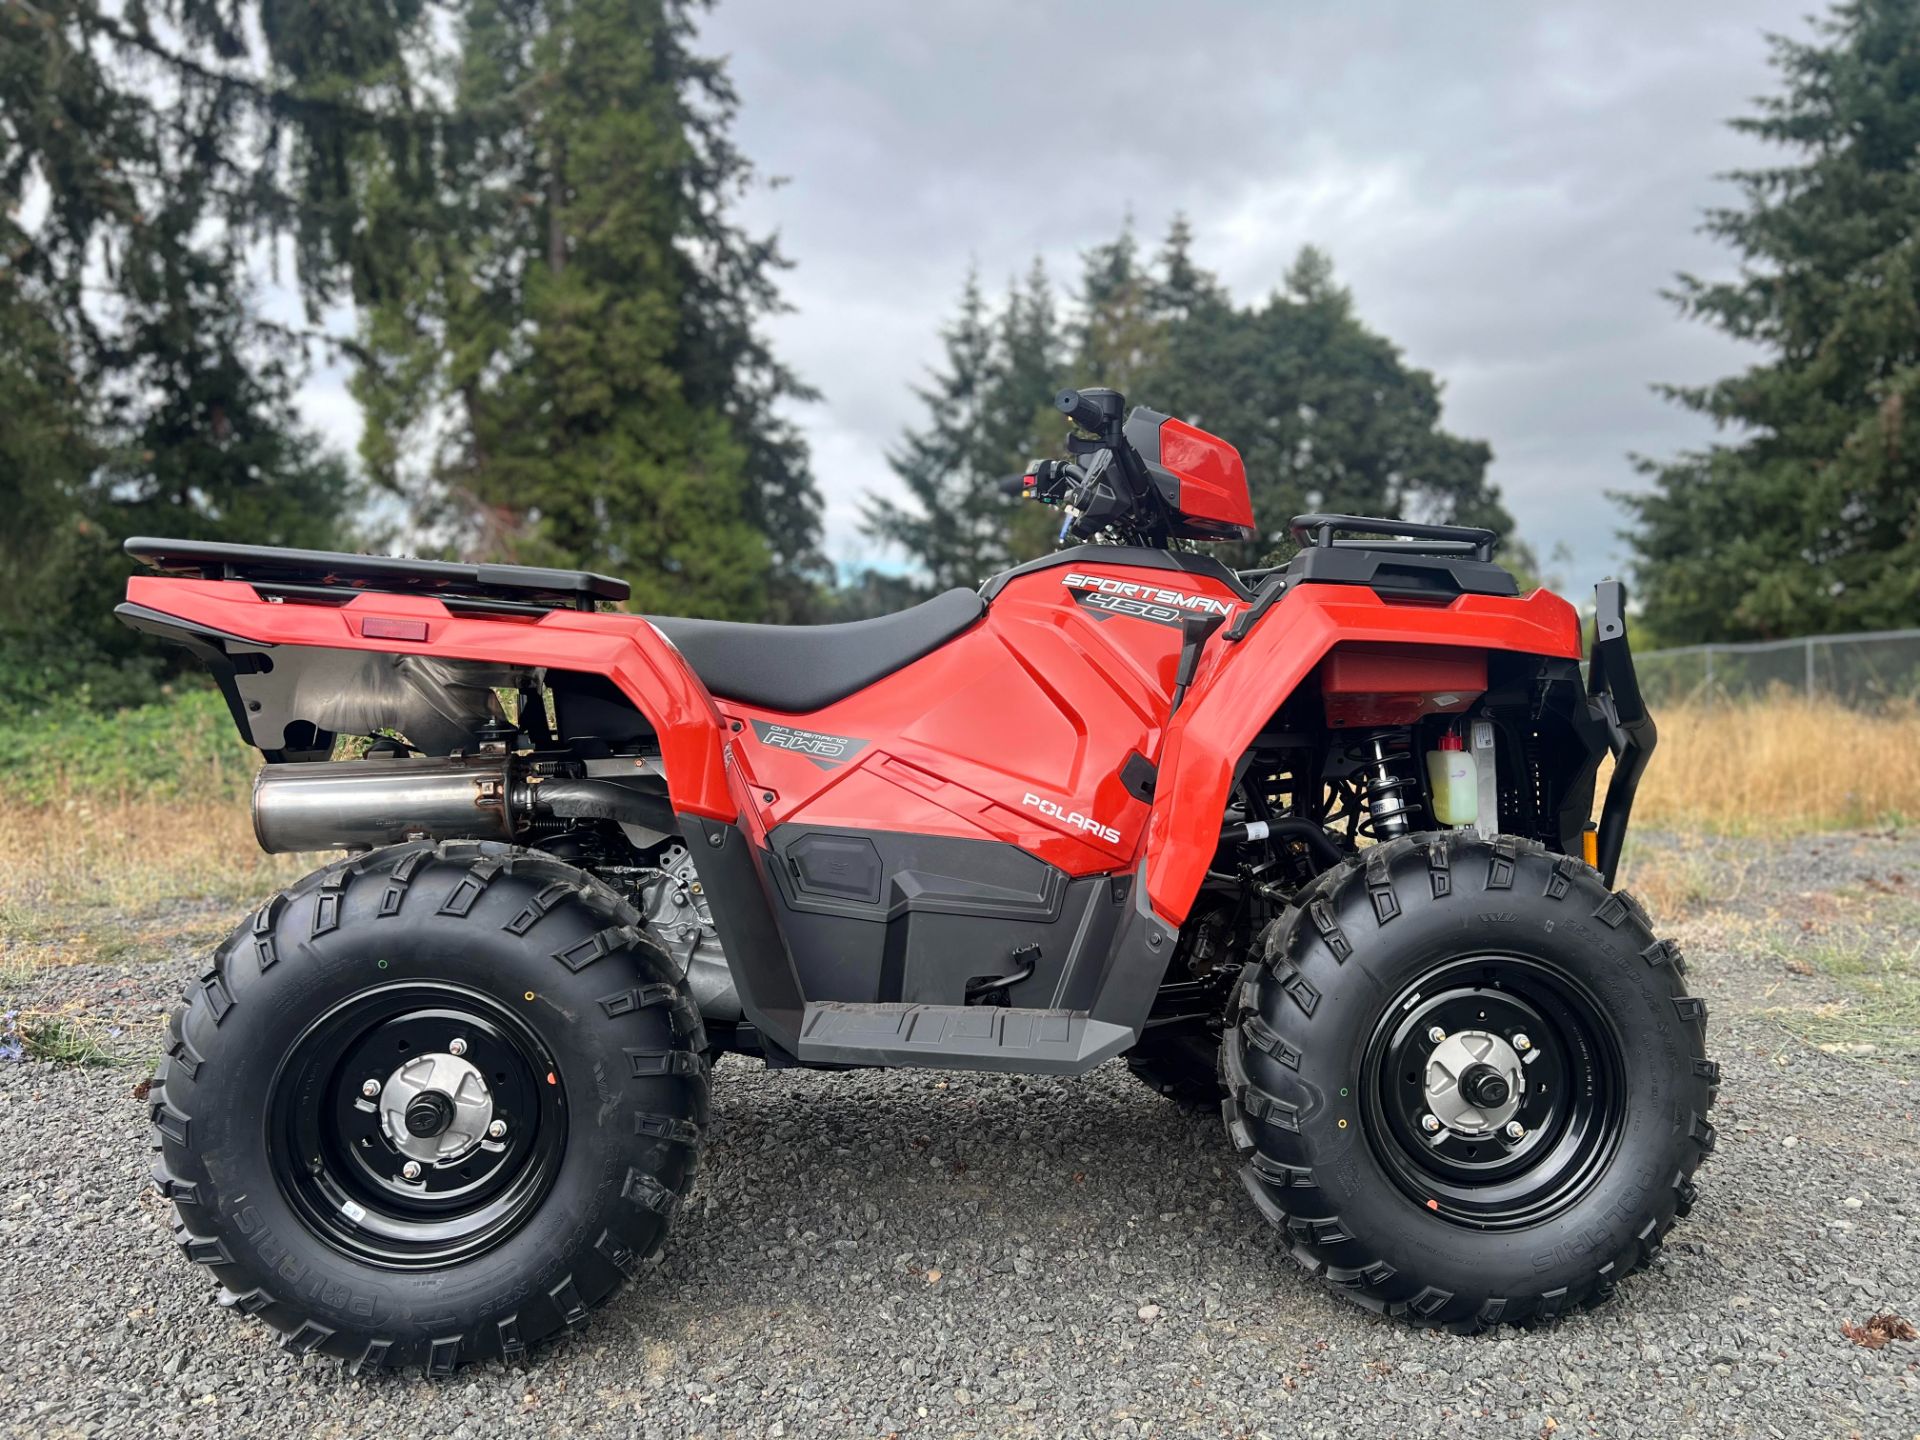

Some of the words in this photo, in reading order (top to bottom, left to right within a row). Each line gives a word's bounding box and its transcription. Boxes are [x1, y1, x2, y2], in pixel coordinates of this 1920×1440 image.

[1061, 572, 1234, 616] SPORTSMAN
[1085, 591, 1180, 622] 450
[762, 731, 845, 757] AWD
[1022, 792, 1121, 844] POLARIS
[232, 1204, 378, 1318] POLARIS
